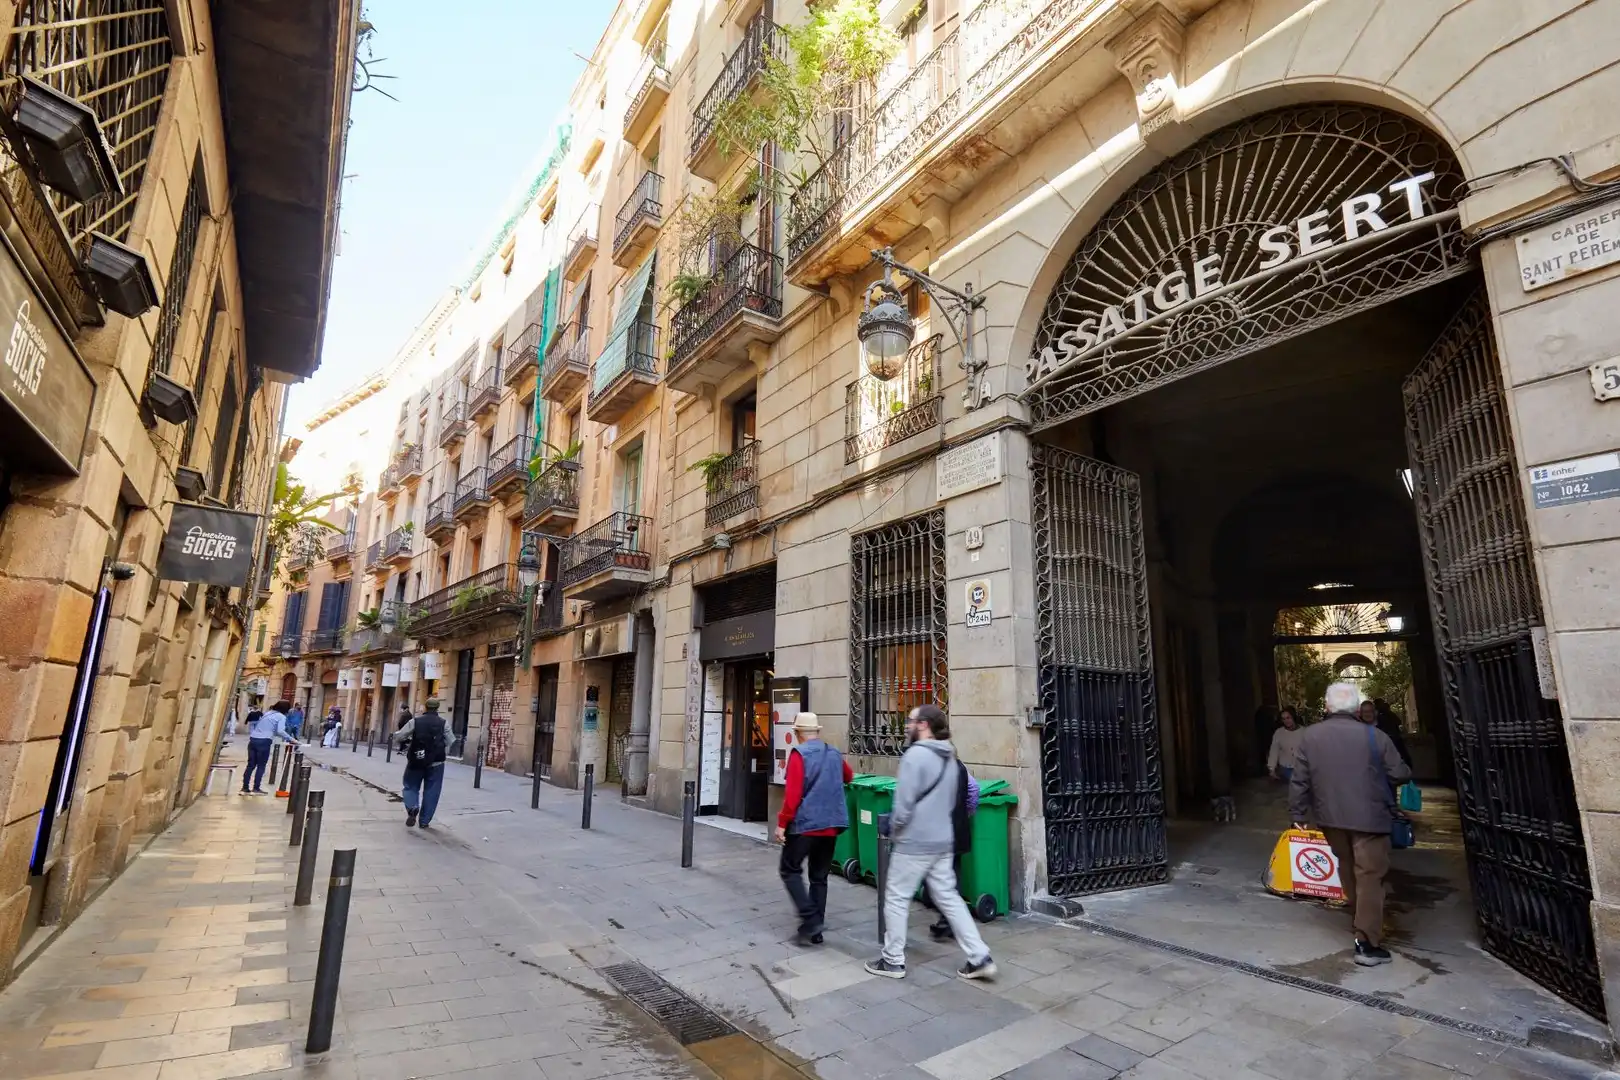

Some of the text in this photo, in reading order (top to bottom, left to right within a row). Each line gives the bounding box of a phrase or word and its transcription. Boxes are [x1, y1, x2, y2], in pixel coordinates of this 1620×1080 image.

[1577, 229, 1600, 245] DE
[1024, 171, 1436, 386] PASSATGE SERT
[1522, 255, 1562, 280] SANT
[17, 299, 47, 353] American
[5, 321, 46, 396] SOCKS
[1561, 483, 1590, 496] 1042
[186, 525, 237, 541] American
[182, 536, 237, 559] SOCKS
